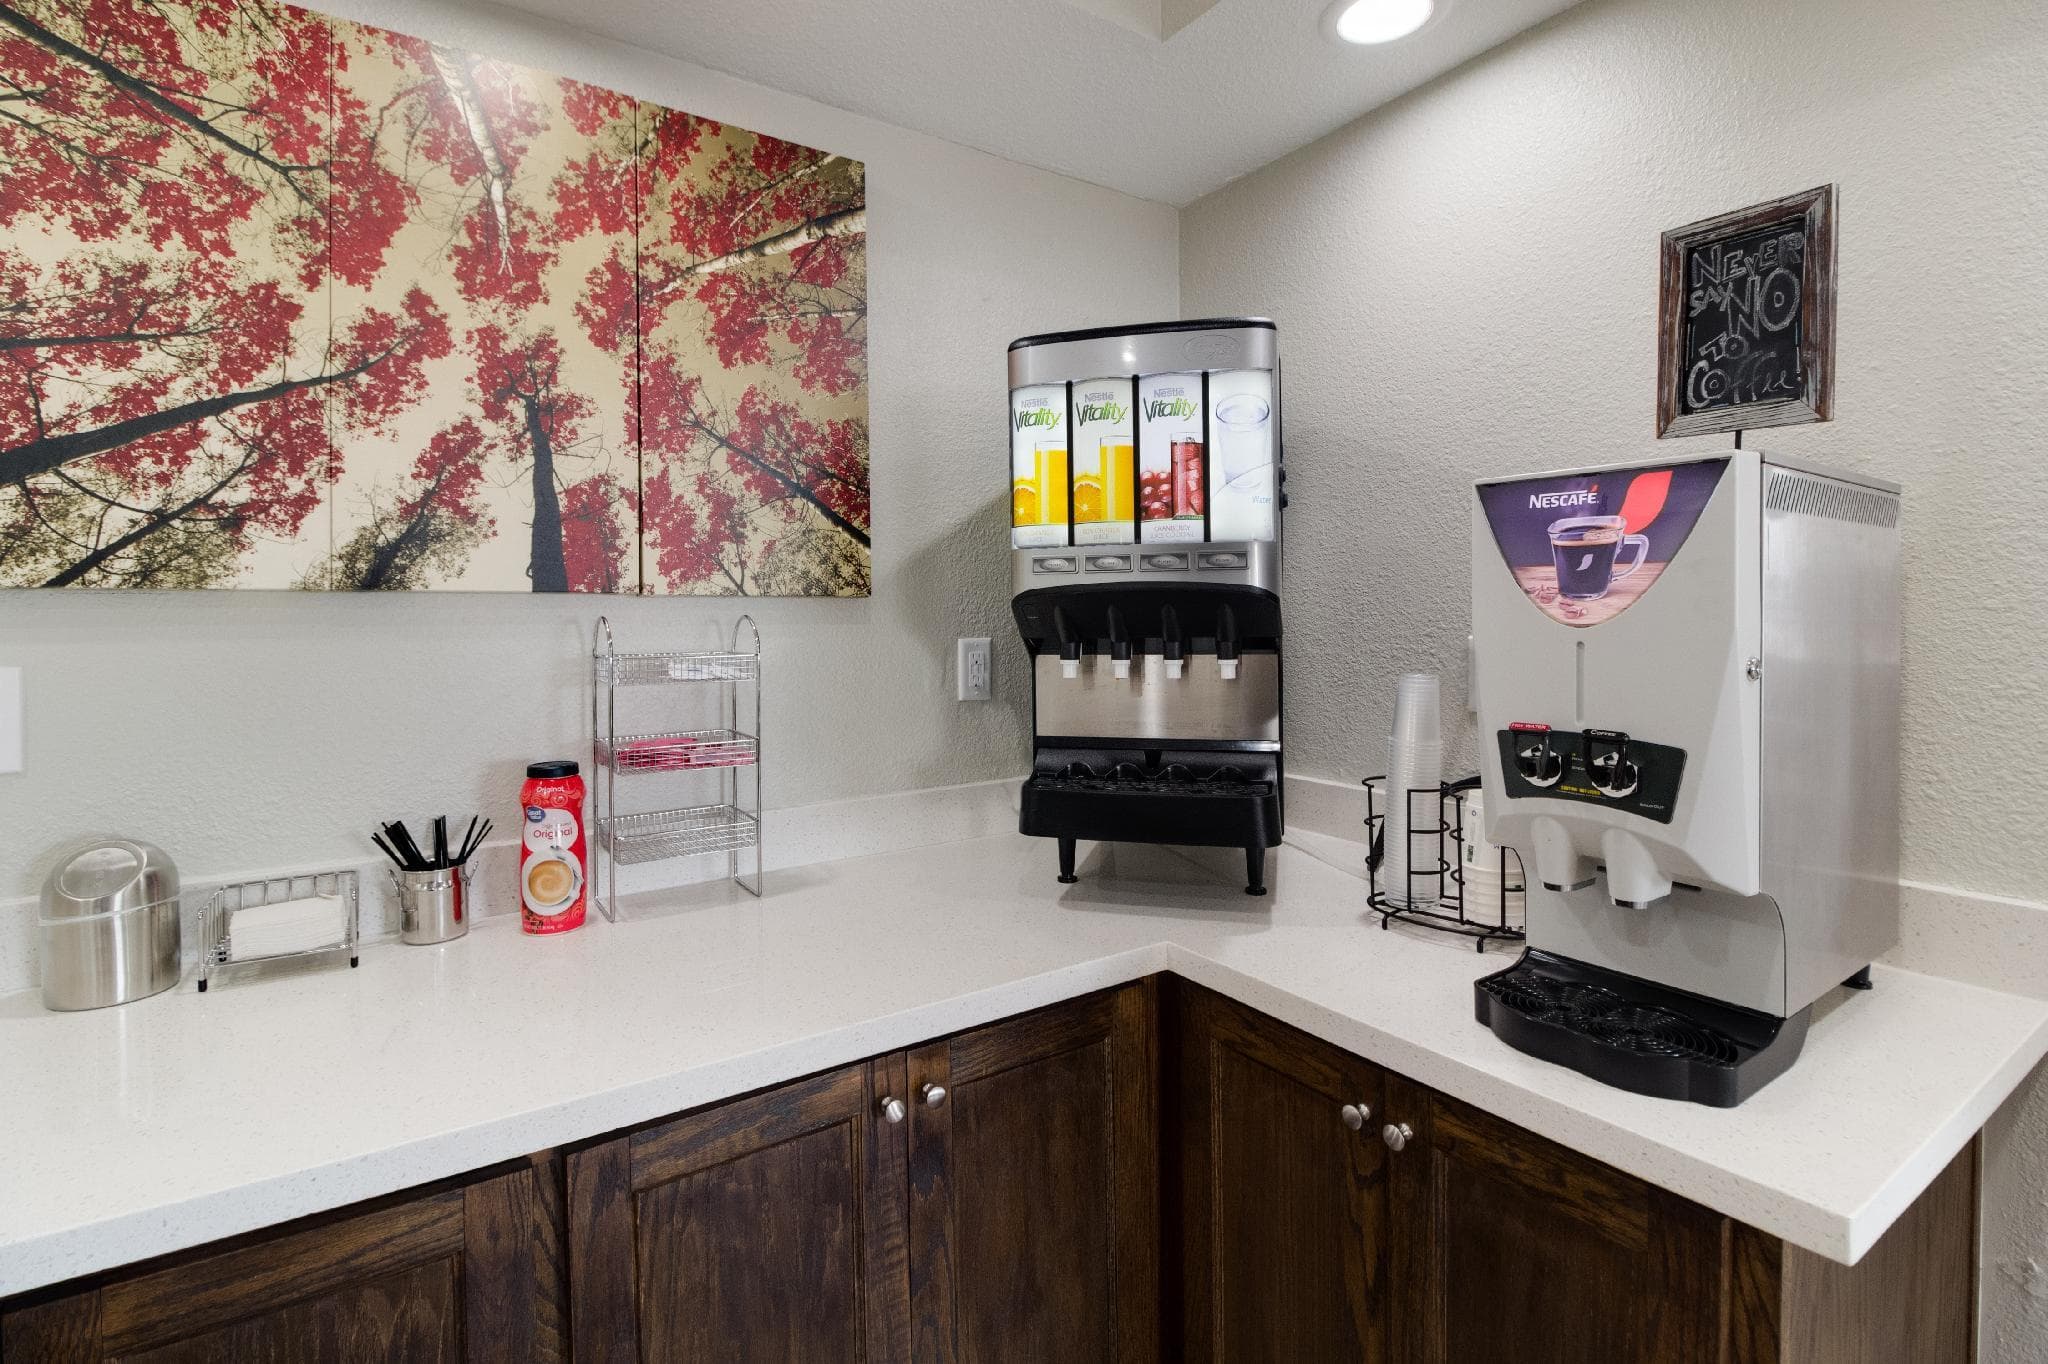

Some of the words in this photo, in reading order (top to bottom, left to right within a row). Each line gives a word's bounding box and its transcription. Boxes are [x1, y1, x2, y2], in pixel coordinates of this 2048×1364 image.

[1691, 232, 1805, 287] NEVER
[1690, 282, 1734, 317] SAY
[1727, 267, 1801, 340] NO
[1698, 331, 1748, 361] TO
[1013, 407, 1062, 433] Vitality
[1076, 401, 1129, 427] Vitality
[1143, 397, 1198, 423] Vitality
[1529, 484, 1599, 509] NESCAFÉ
[536, 786, 565, 794] Original
[533, 827, 573, 840] Original
